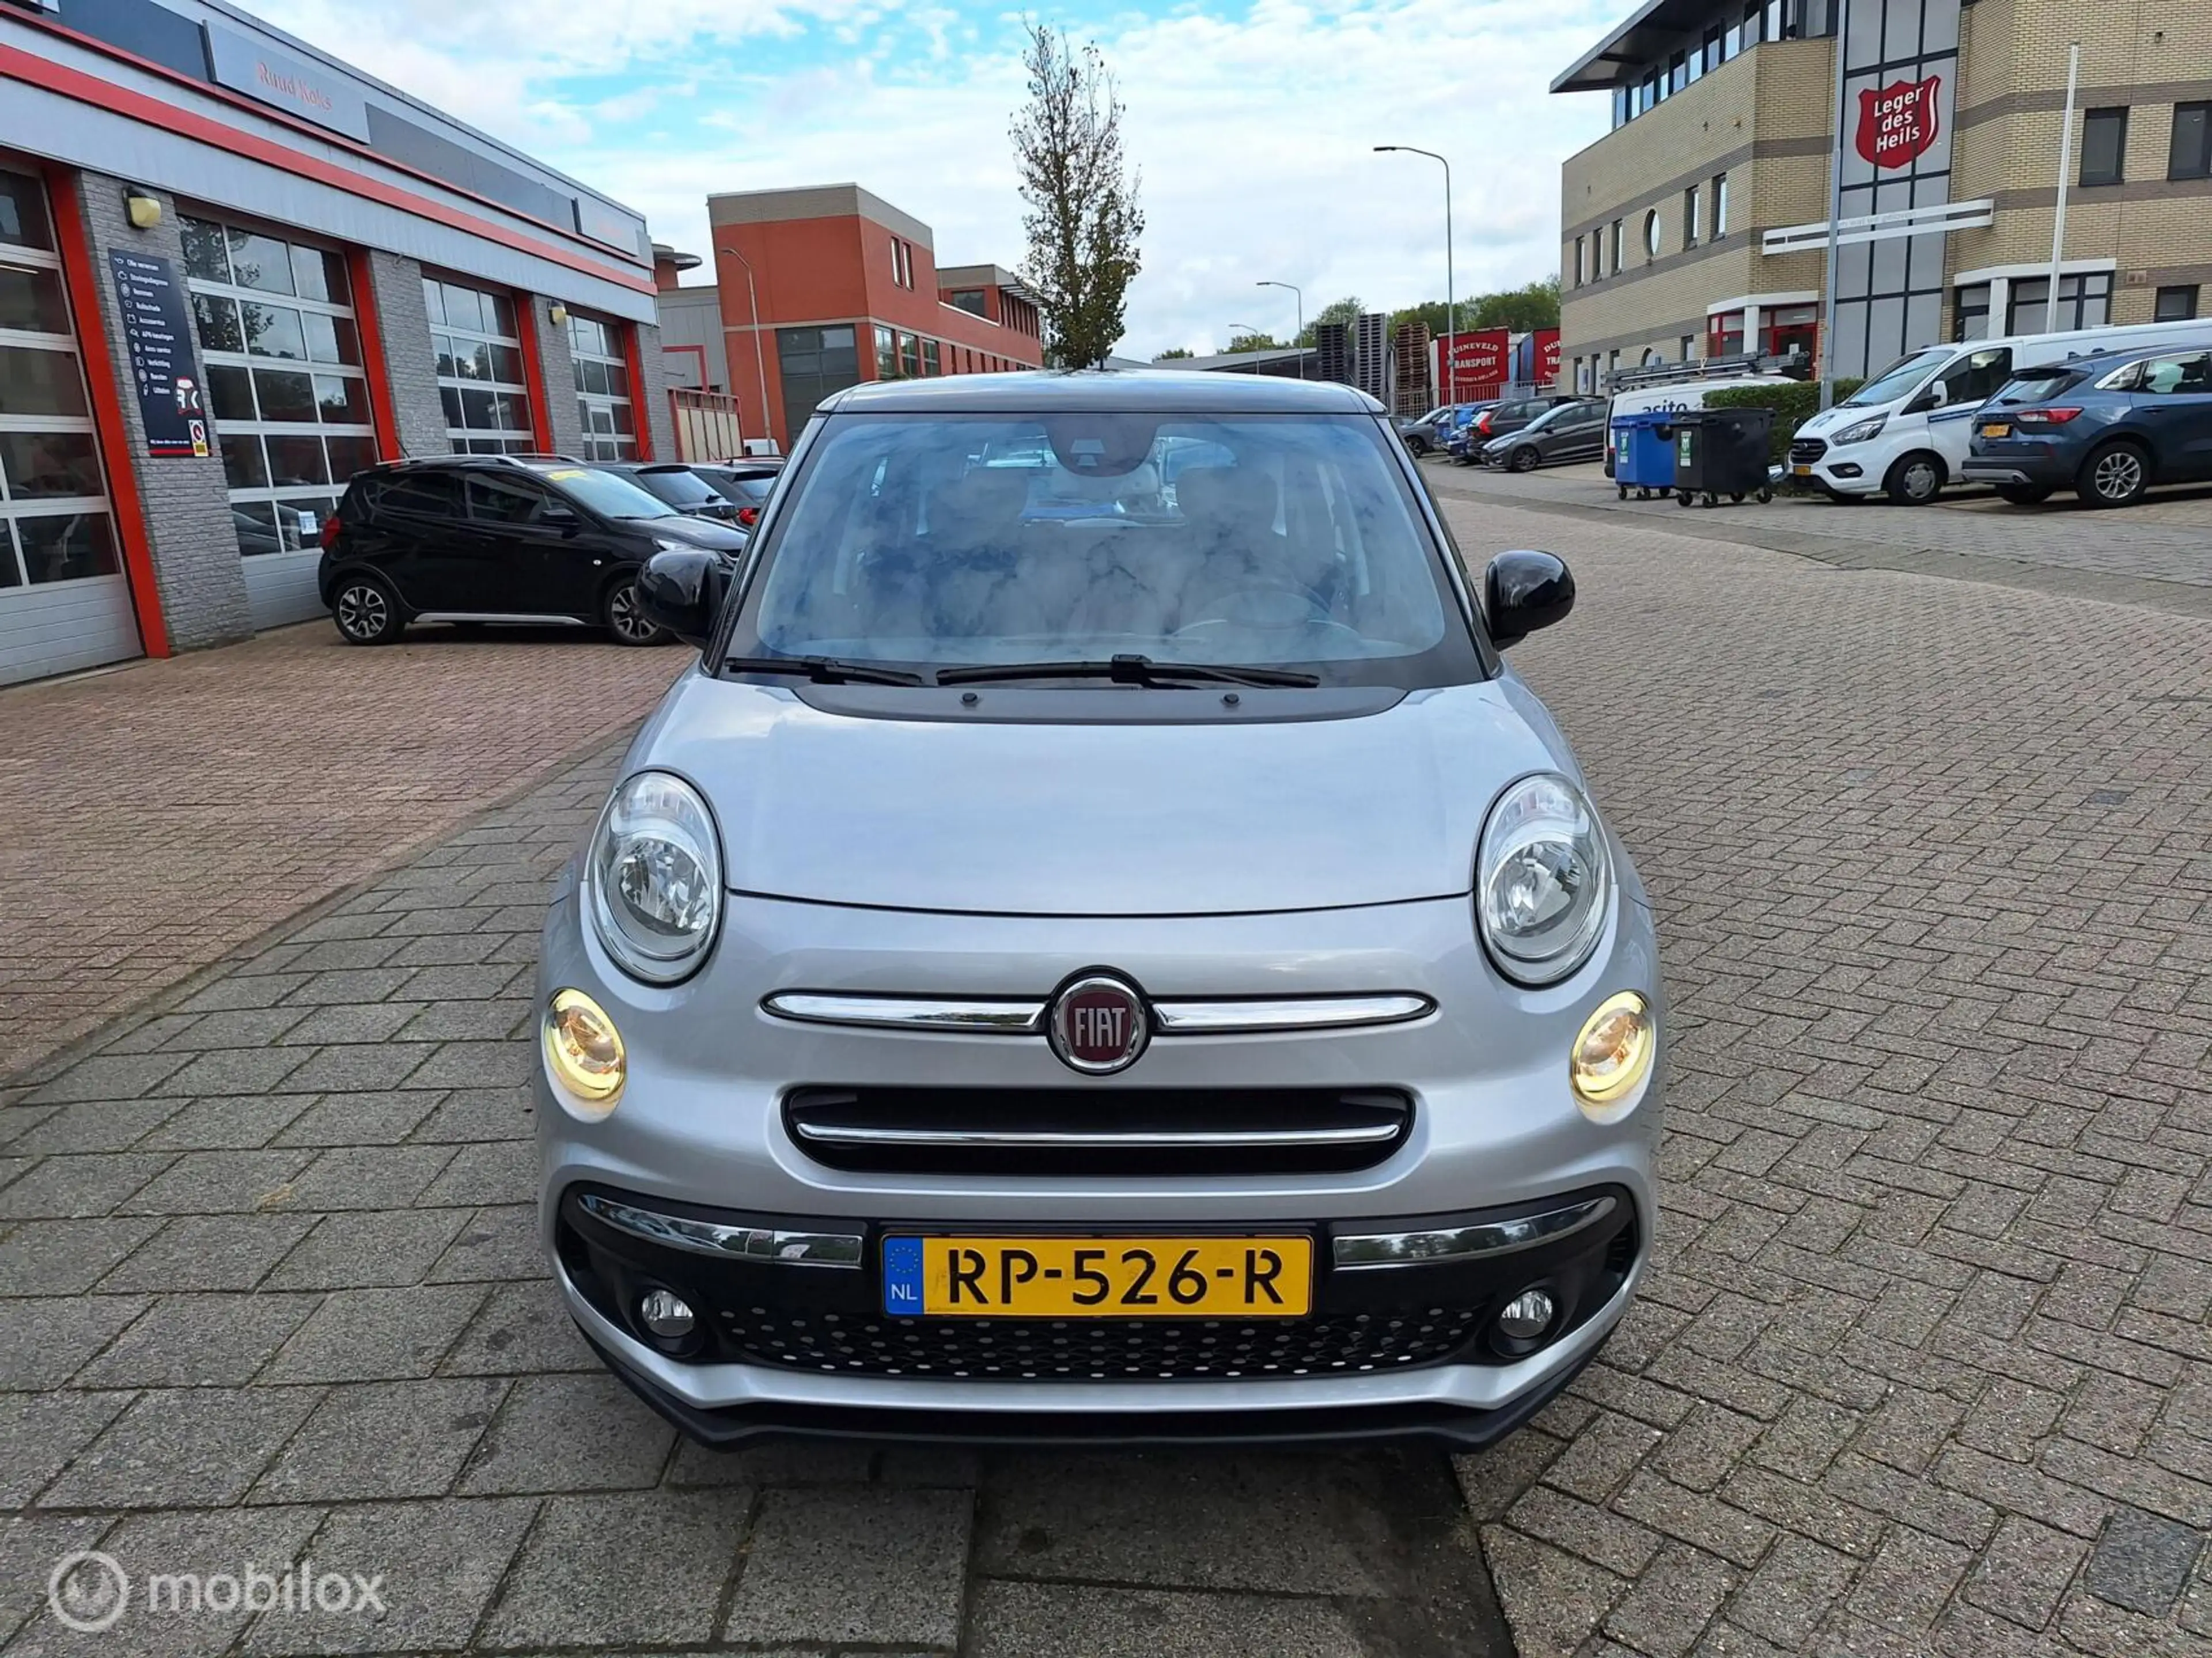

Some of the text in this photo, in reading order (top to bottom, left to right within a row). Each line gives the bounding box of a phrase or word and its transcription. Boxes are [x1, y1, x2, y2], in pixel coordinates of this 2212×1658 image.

[1874, 86, 1924, 117] Leger
[1882, 110, 1913, 132] des
[1876, 126, 1920, 153] Heils
[1074, 1007, 1126, 1048] FIAT
[891, 1248, 1285, 1306] NL RP-526-R
